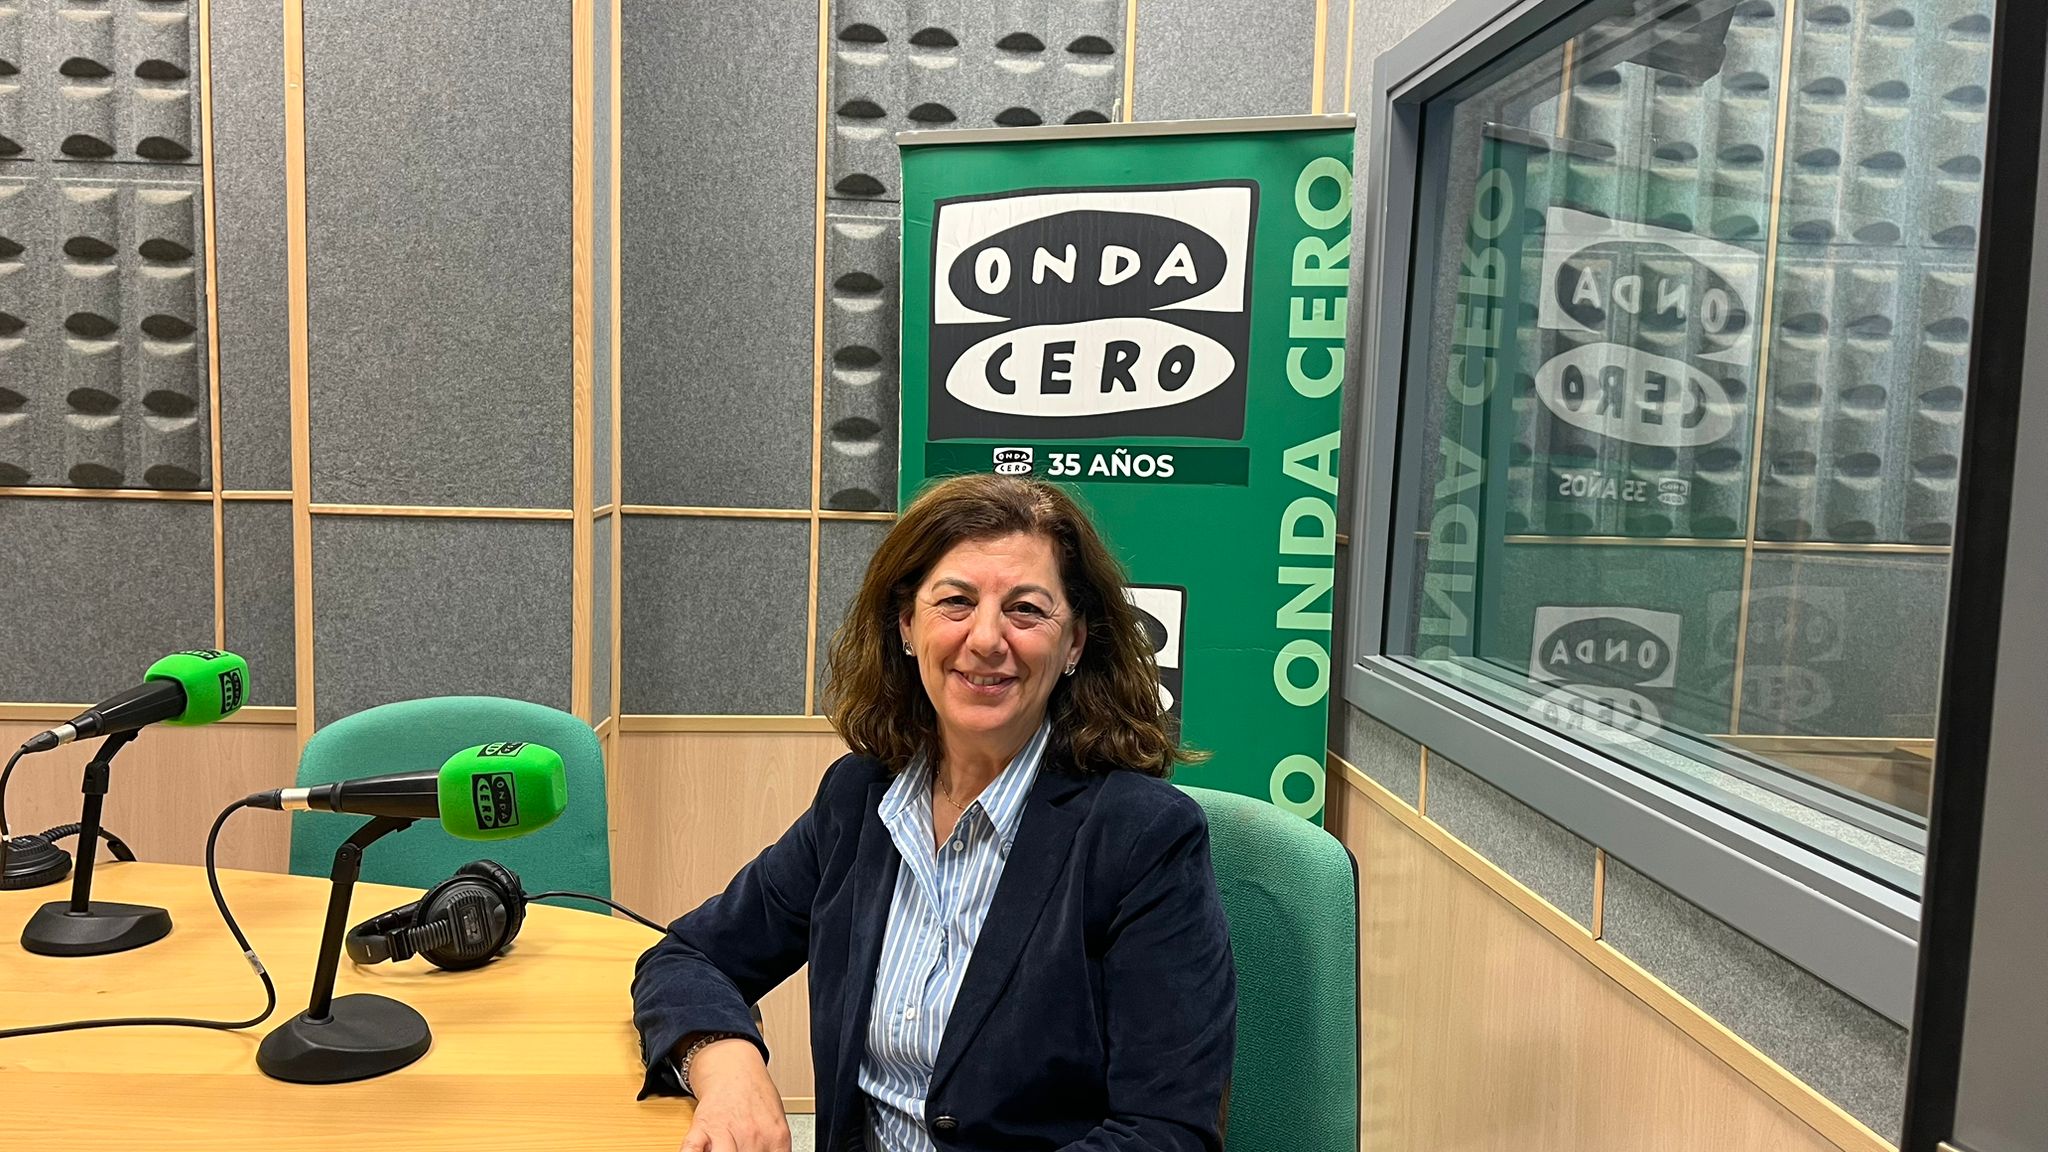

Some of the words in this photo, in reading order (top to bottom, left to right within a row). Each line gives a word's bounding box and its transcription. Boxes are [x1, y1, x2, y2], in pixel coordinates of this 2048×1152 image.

[974, 242, 1198, 295] ONDA
[1286, 156, 1354, 398] CERO
[985, 340, 1196, 395] CERO
[997, 452, 1028, 461] ONDA
[1000, 464, 1027, 472] CERO
[1047, 453, 1082, 476] 35
[1087, 448, 1175, 478] AÑOS
[1273, 430, 1342, 707] ONDA
[479, 784, 493, 822] CERO
[496, 781, 509, 819] ONDA
